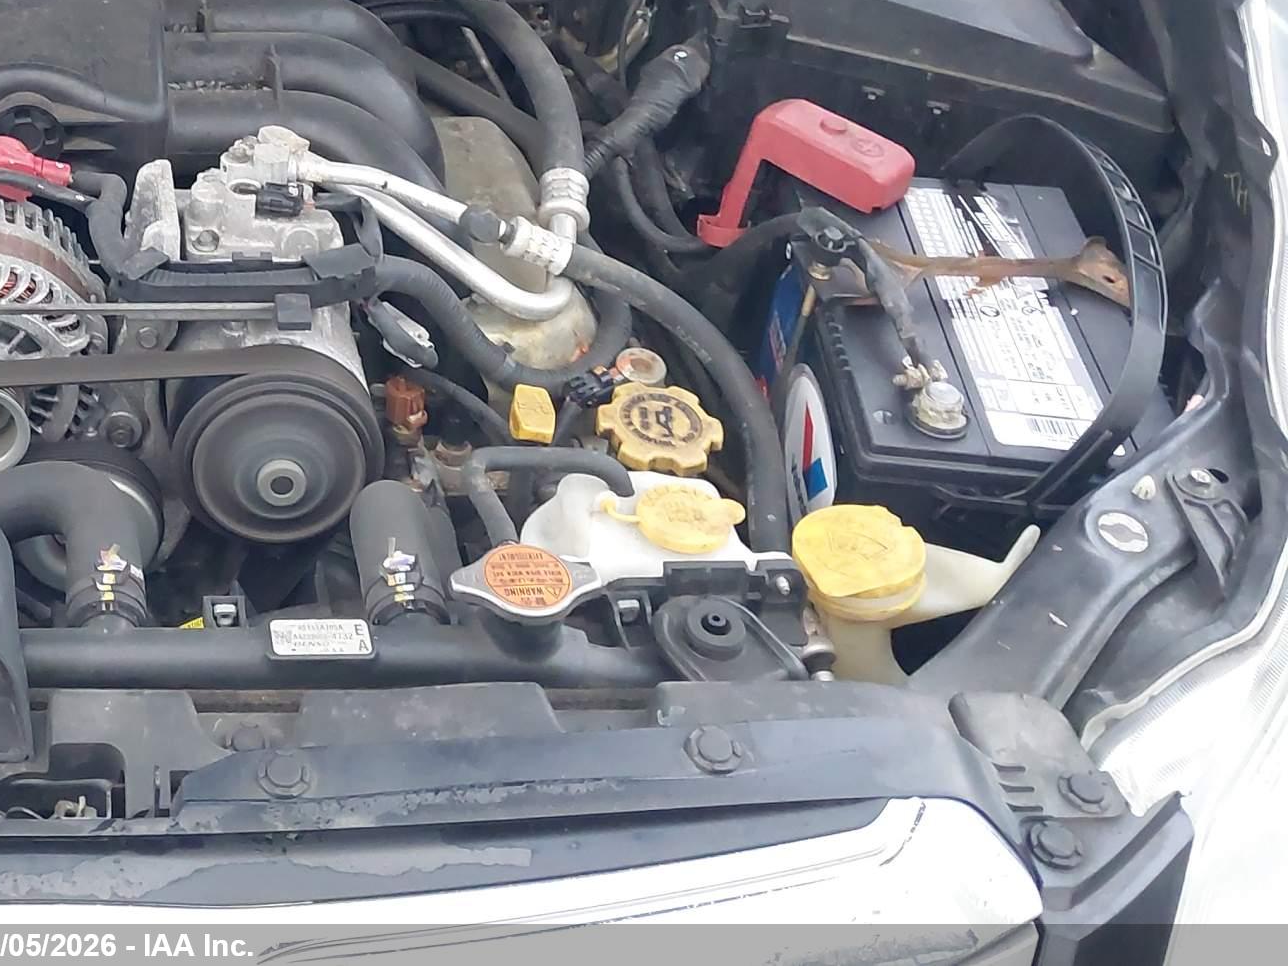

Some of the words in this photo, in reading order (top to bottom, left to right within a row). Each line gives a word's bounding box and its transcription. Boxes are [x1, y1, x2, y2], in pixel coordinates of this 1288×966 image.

[503, 586, 545, 597] WARNING
[354, 624, 364, 636] E
[358, 639, 369, 652] A
